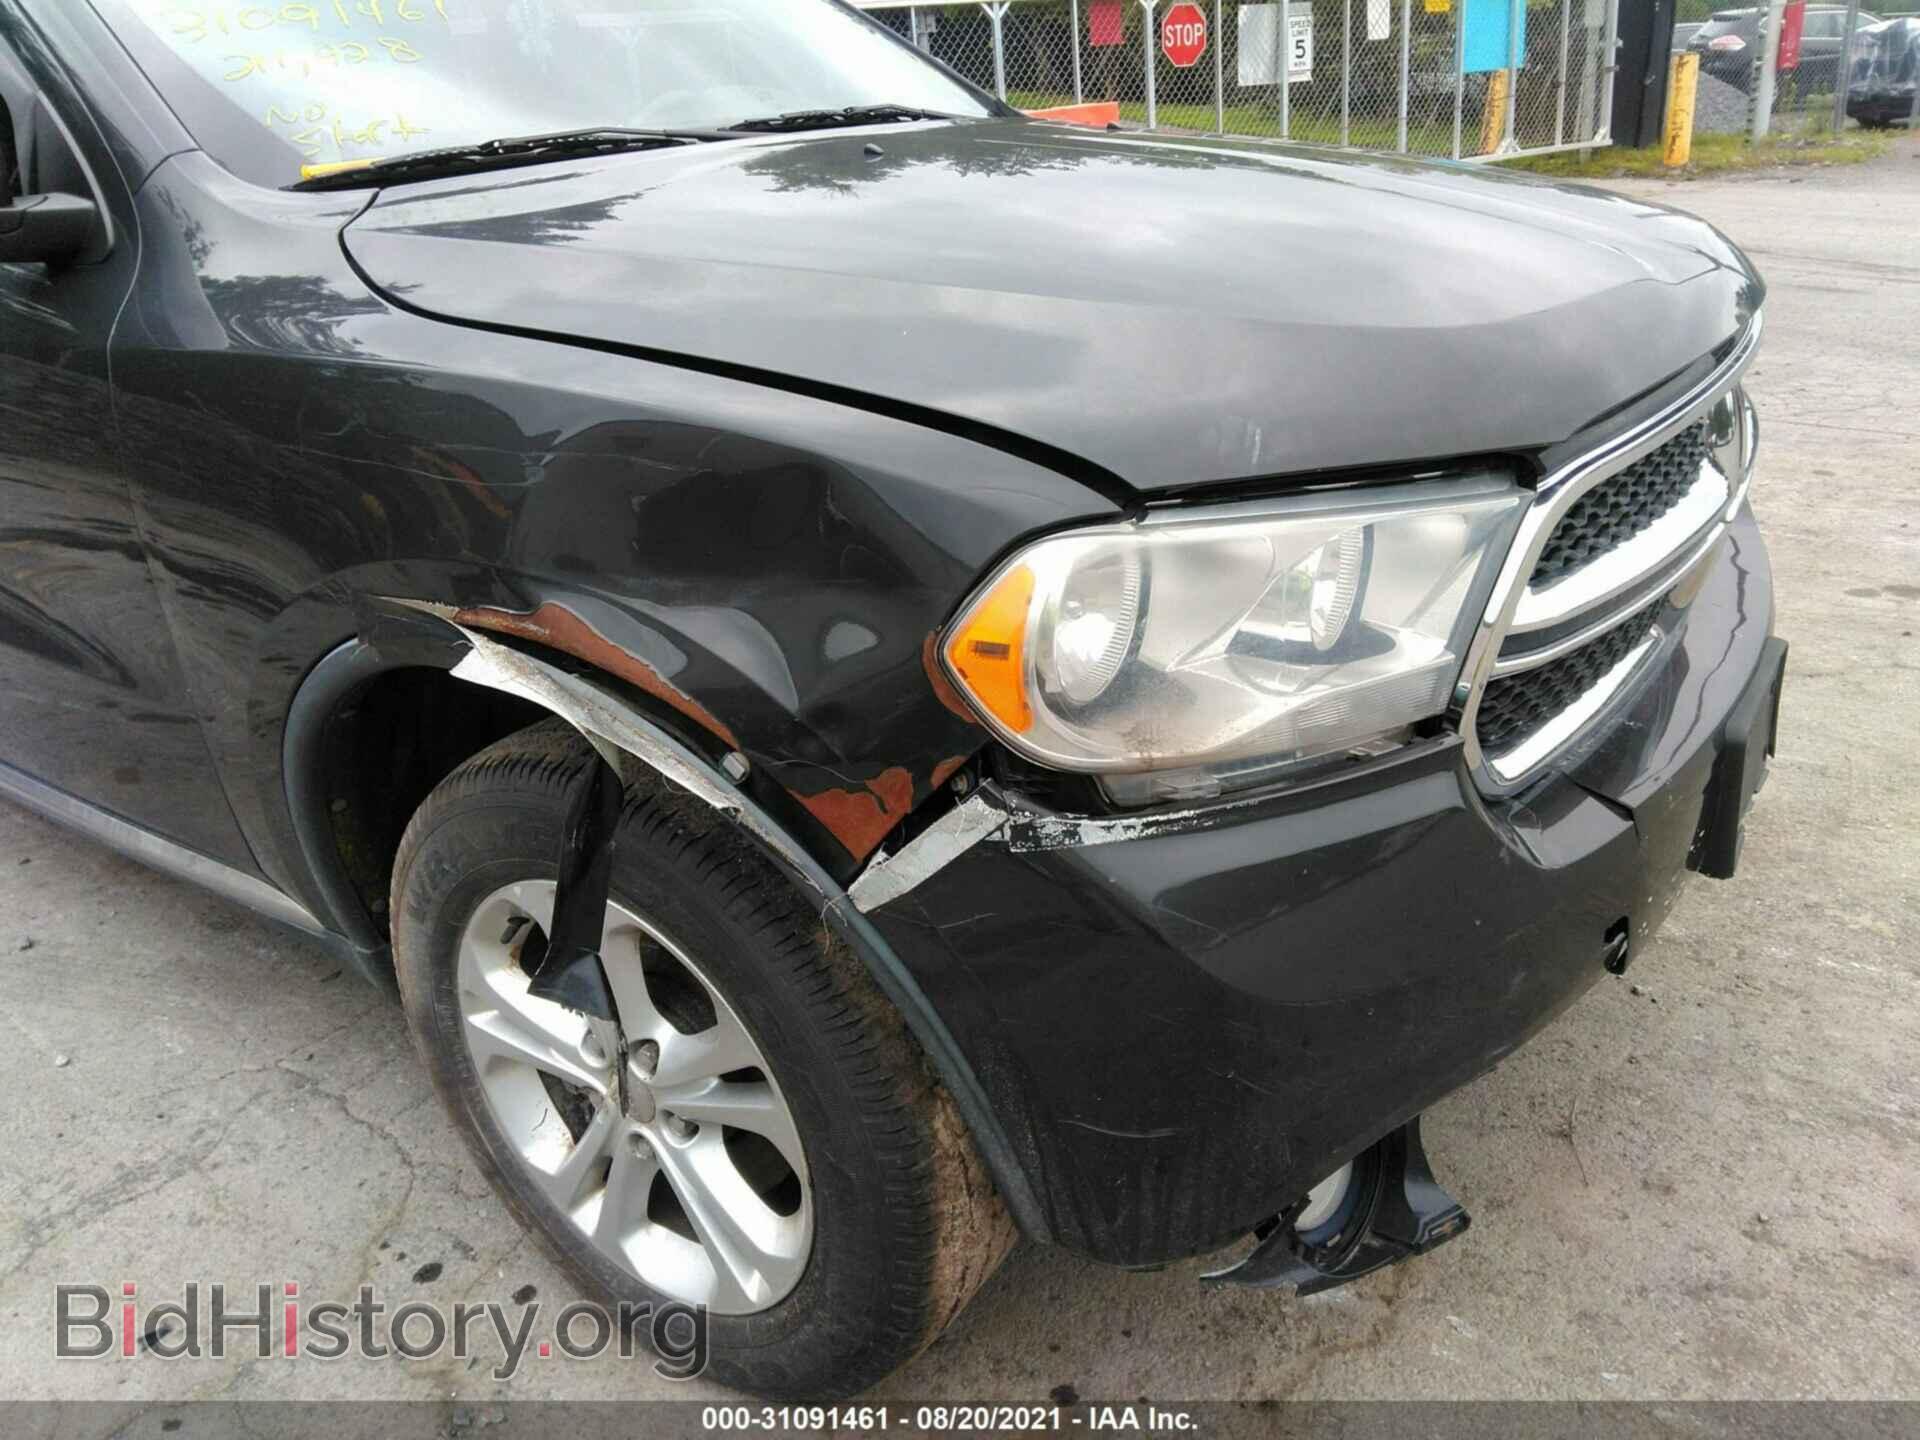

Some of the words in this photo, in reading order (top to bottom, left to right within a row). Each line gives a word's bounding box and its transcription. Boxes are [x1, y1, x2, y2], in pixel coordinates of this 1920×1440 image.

[1289, 20, 1312, 29] SPEED
[1165, 23, 1204, 47] STOP
[1291, 28, 1309, 36] LIMIT
[1295, 39, 1306, 59] 5
